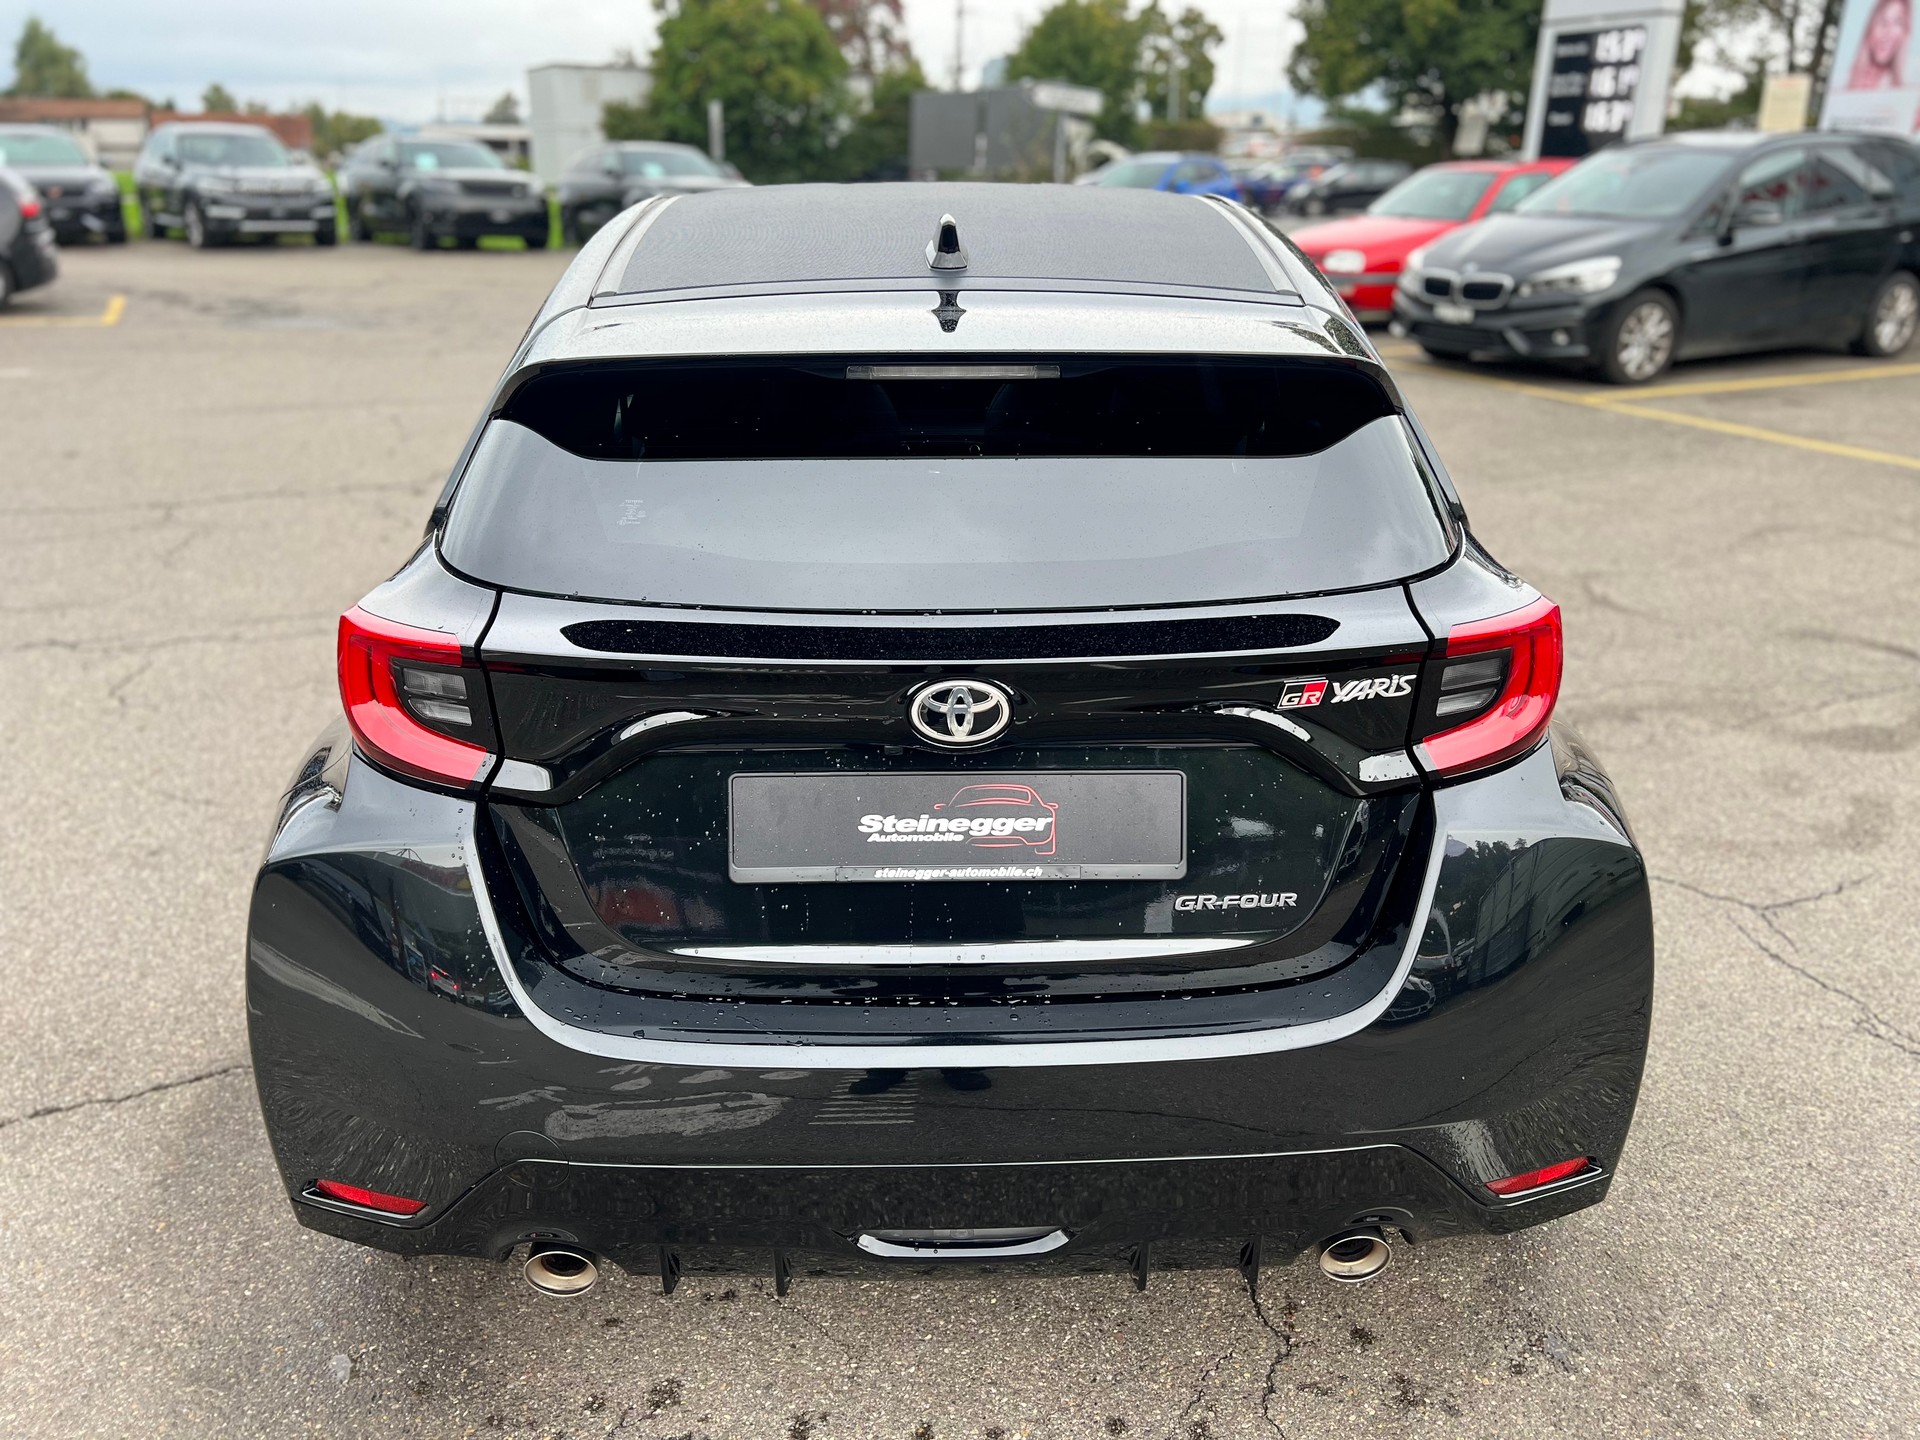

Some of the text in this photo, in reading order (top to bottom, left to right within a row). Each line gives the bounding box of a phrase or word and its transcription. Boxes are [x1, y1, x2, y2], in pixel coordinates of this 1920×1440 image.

[857, 814, 1054, 836] Steinegger
[867, 832, 965, 843] Automobile
[874, 866, 1043, 880] steinegger-automobile.ch
[1174, 892, 1298, 911] GR-FOUR
